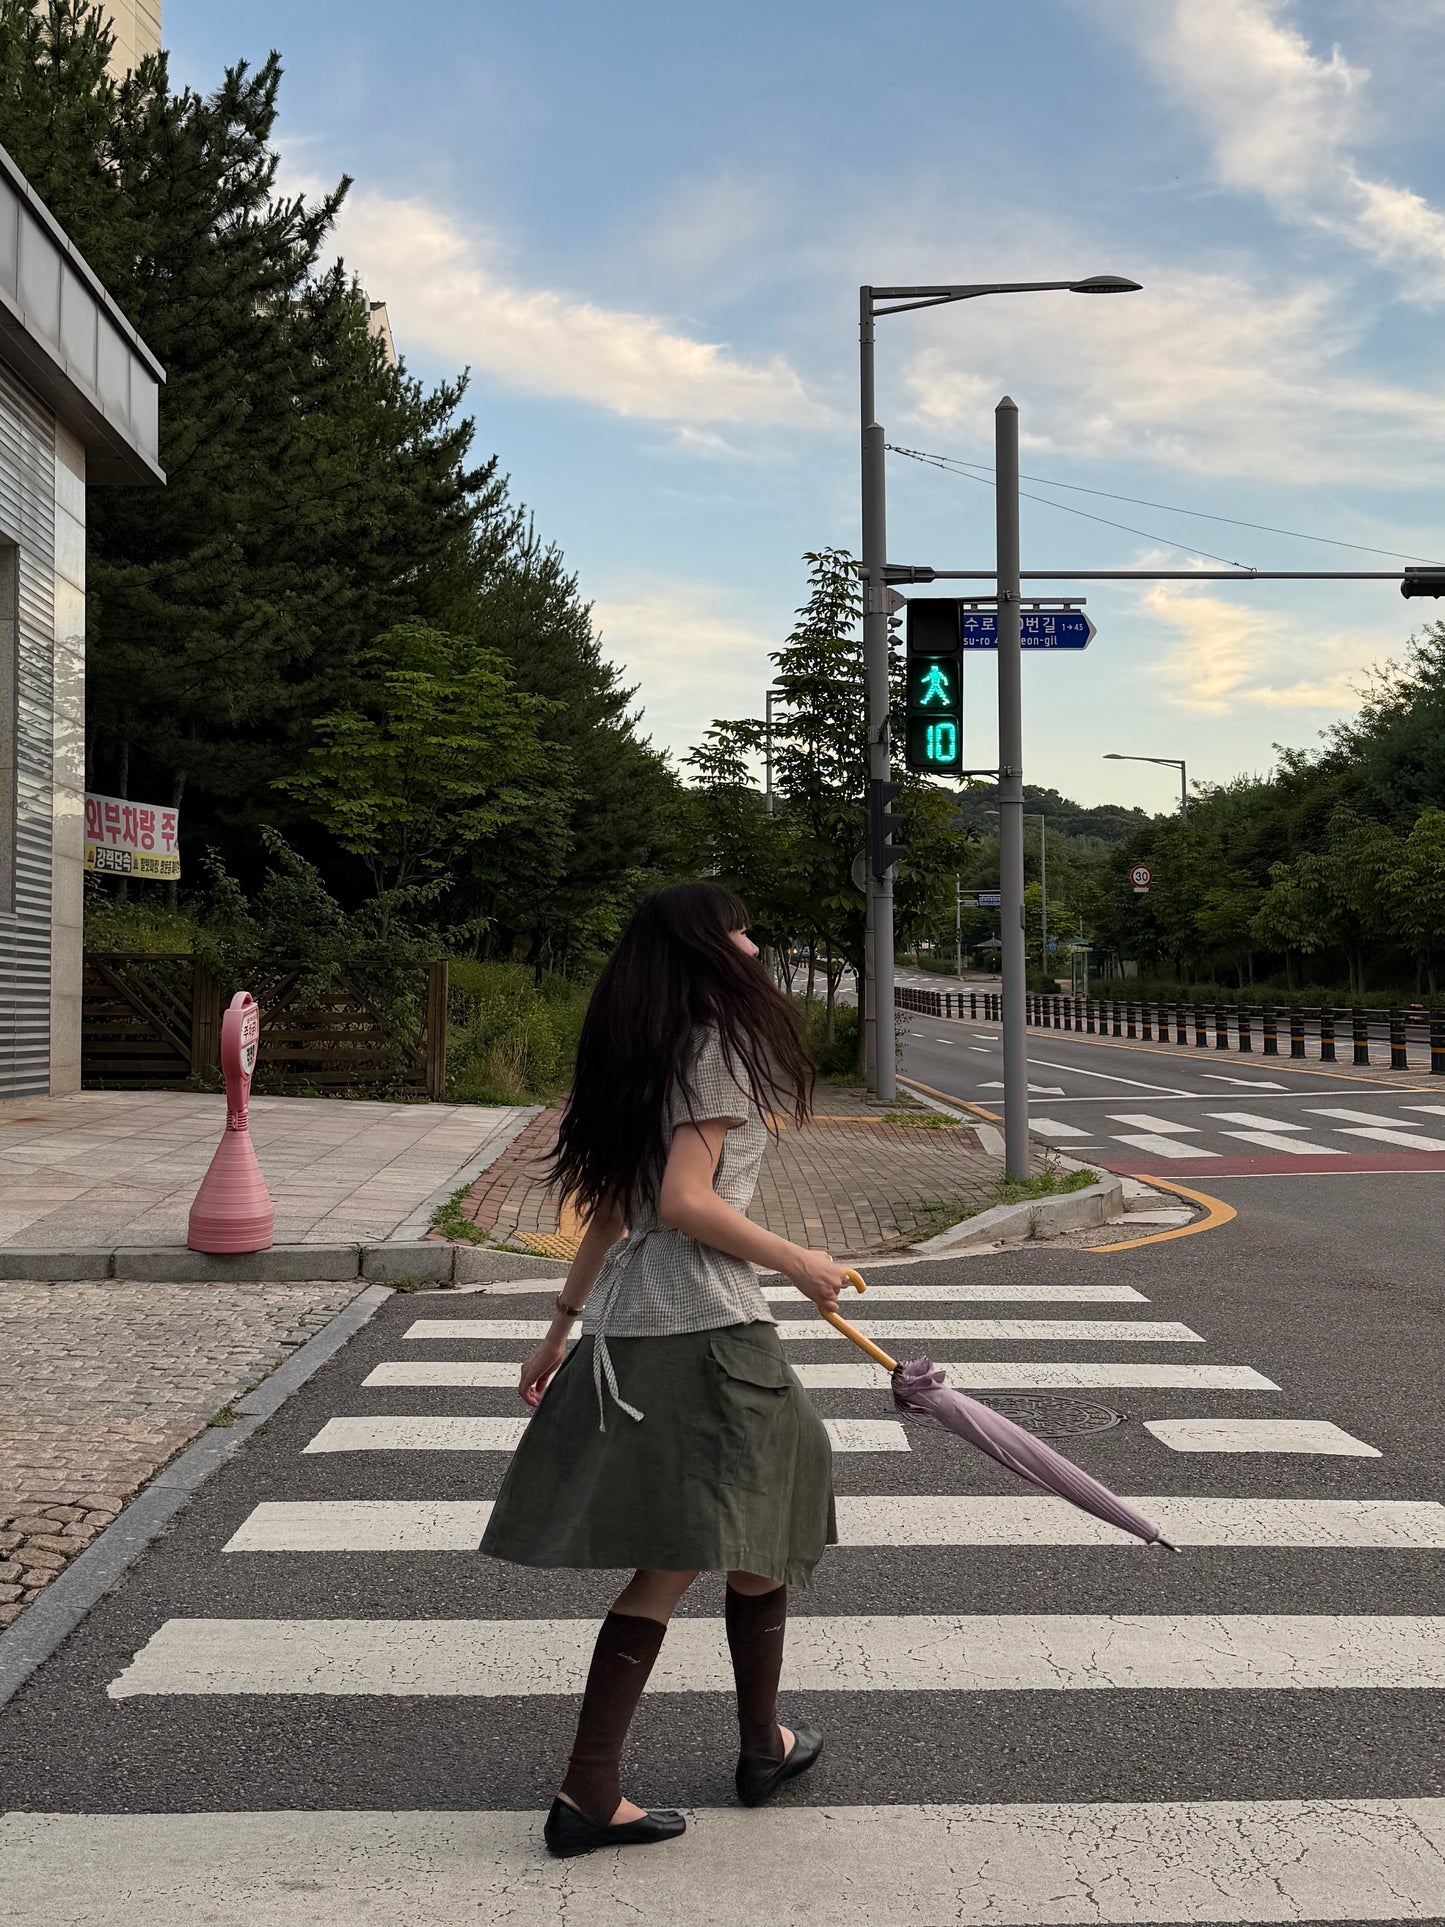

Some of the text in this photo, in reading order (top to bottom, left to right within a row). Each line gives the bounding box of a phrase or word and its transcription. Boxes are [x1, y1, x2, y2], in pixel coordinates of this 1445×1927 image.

[927, 723, 956, 761] 10
[85, 799, 179, 852] 외부차량 주
[97, 848, 131, 872] 강력단속
[1135, 871, 1149, 882] 30
